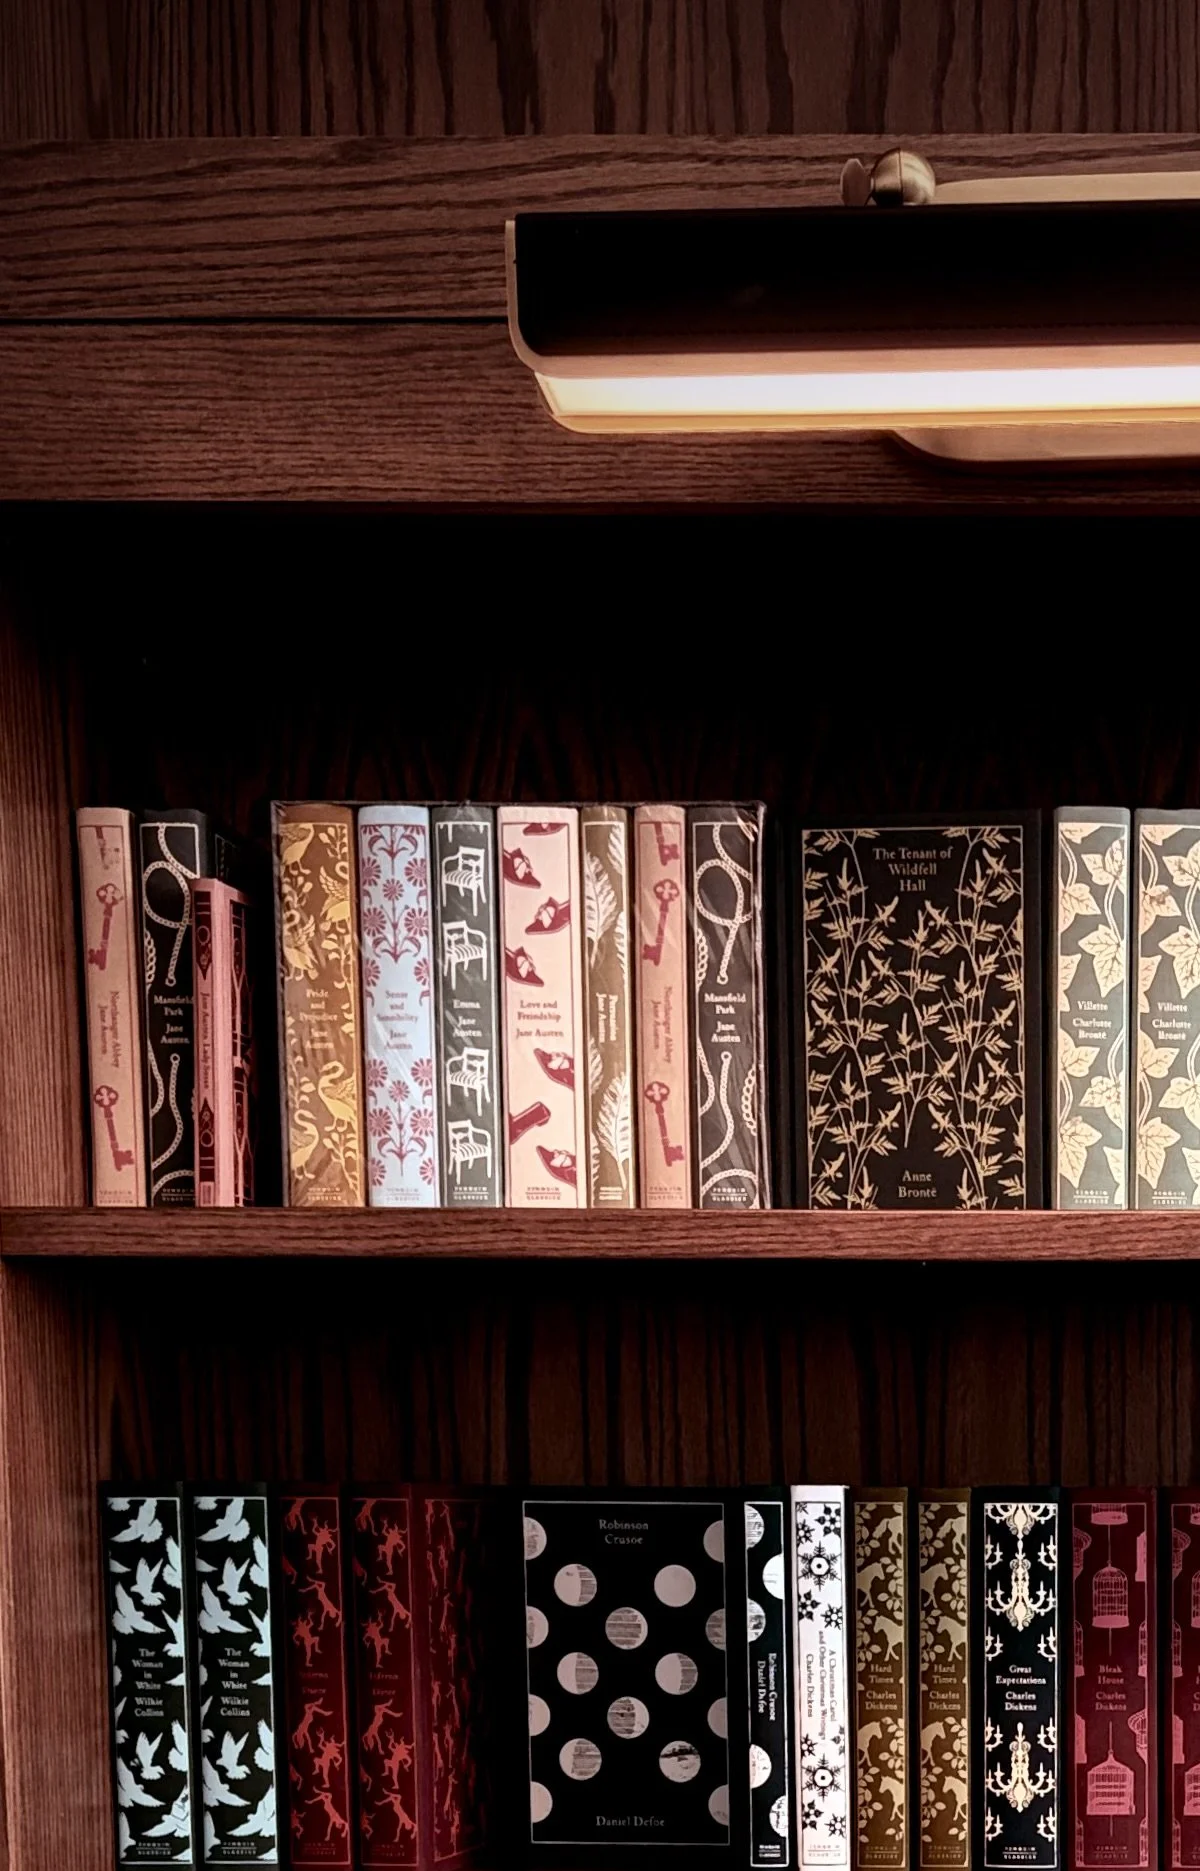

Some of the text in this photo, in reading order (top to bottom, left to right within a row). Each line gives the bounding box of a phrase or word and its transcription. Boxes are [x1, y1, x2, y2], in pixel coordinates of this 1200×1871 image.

[873, 846, 952, 859] The Tenant of
[888, 863, 937, 875] Wildfell
[900, 879, 926, 891] Hall
[705, 993, 746, 1002] Mansfield
[453, 1001, 480, 1009] Emma
[716, 1005, 735, 1014] Park
[1078, 1002, 1108, 1012] Villette
[458, 1017, 476, 1026] Jane
[1073, 1018, 1112, 1028] Charlotte
[717, 1022, 735, 1031] Jane
[453, 1029, 482, 1037] Austen
[516, 1029, 532, 1038] Jane
[712, 1034, 740, 1042] Austen
[902, 1170, 931, 1182] Anne
[600, 1520, 649, 1530] Robinson
[605, 1534, 642, 1544] Crusoe
[218, 1659, 249, 1668] Woman
[1009, 1665, 1031, 1673] Great
[996, 1676, 1046, 1685] Expectations
[222, 1681, 247, 1690] White
[1005, 1692, 1036, 1700] Charles
[221, 1697, 248, 1705] Wilkie
[1005, 1702, 1036, 1711] Dickens
[596, 1816, 664, 1826] Daniel Defoe
